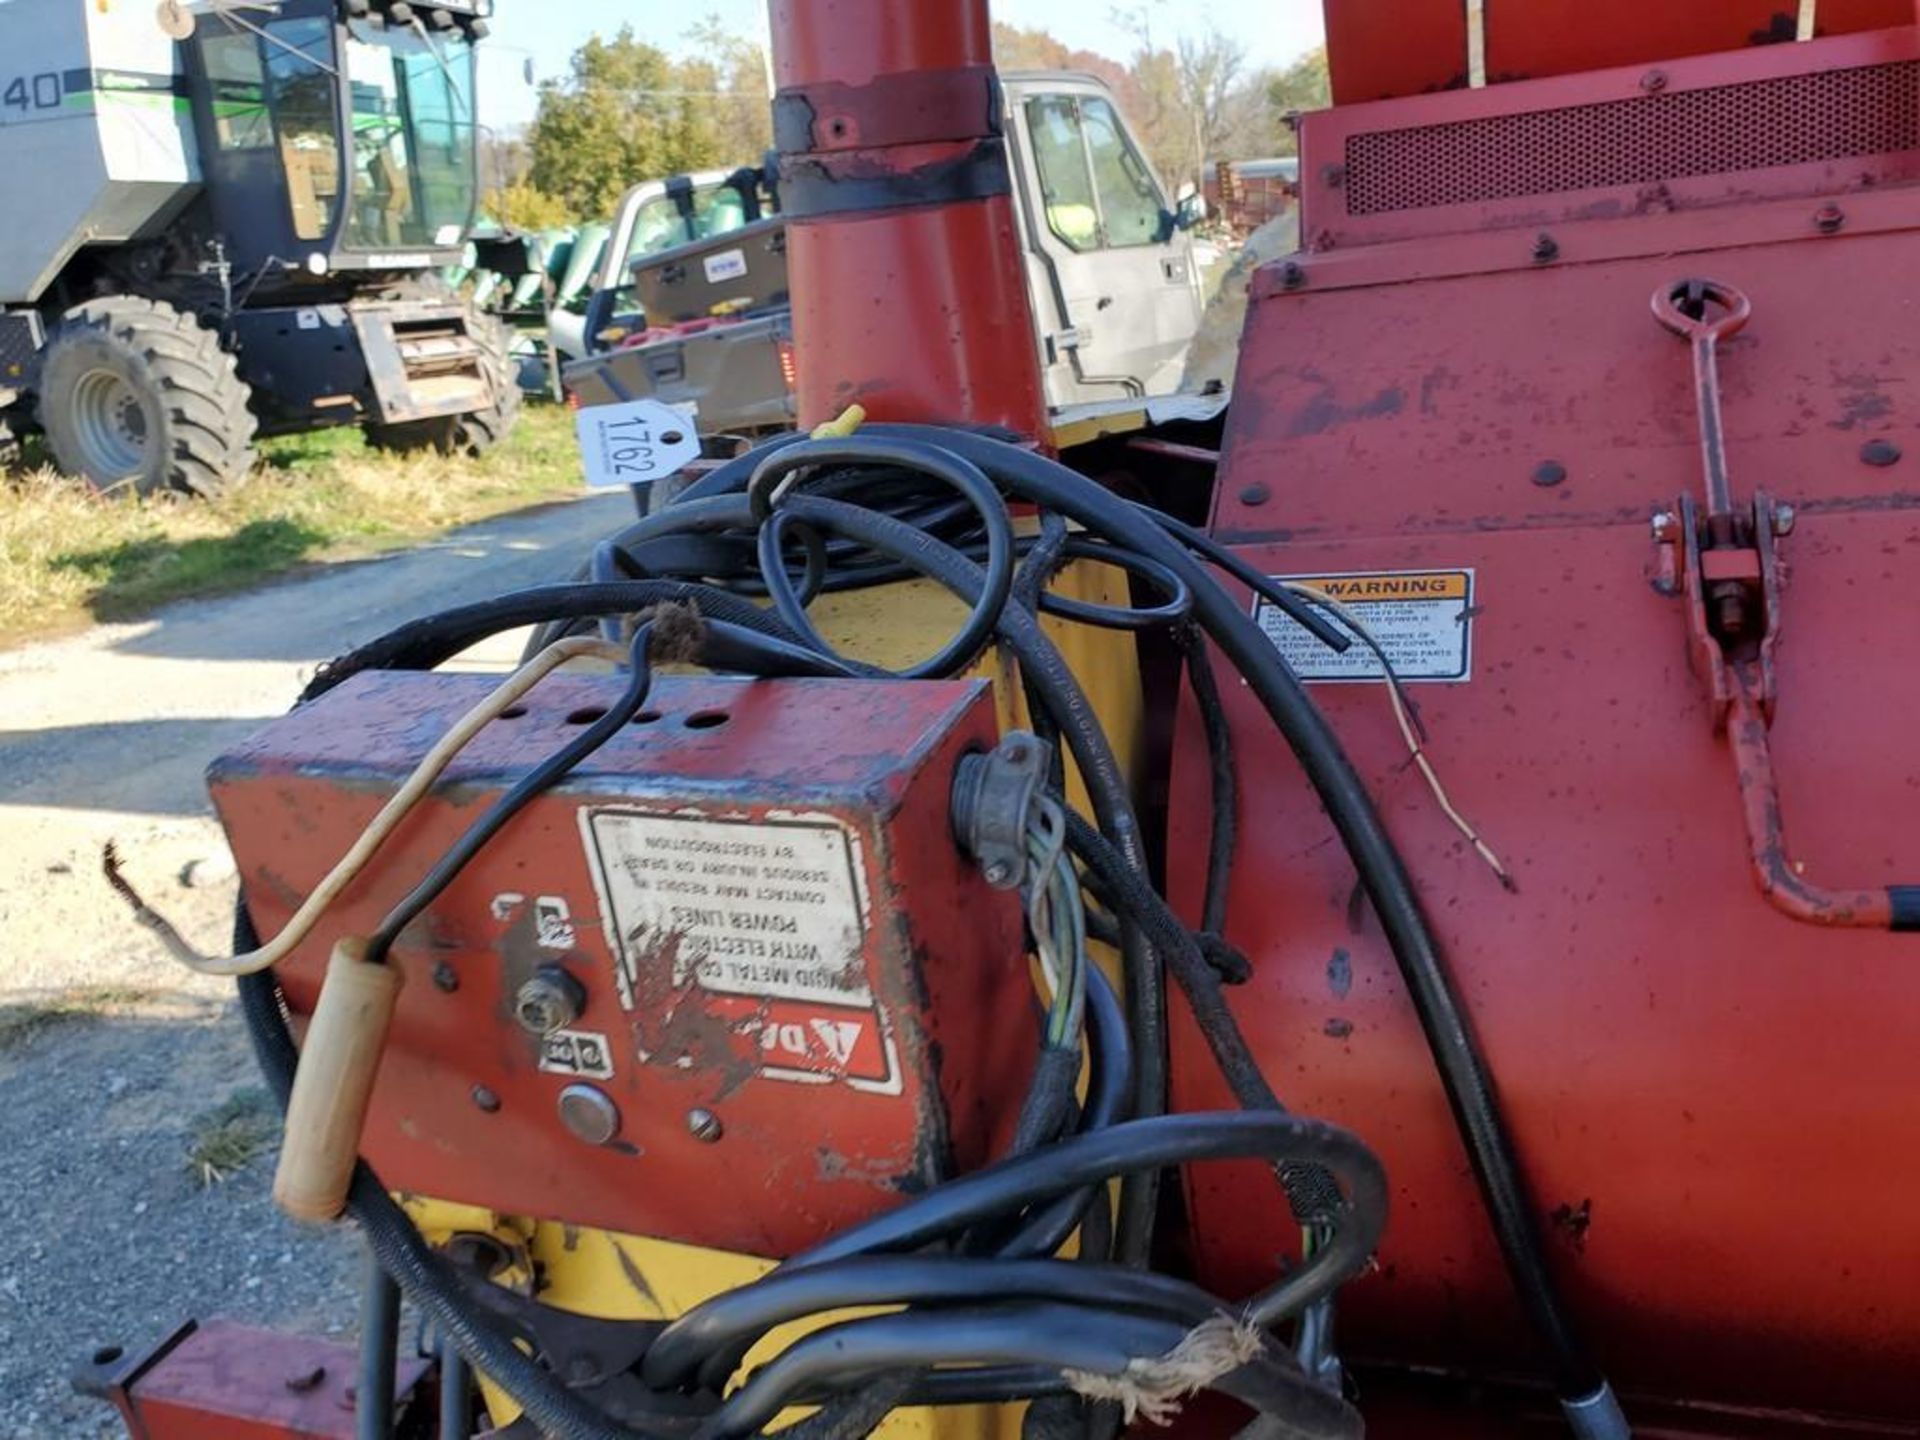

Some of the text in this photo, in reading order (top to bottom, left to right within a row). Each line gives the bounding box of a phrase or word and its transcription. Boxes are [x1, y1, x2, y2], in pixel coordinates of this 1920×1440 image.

[608, 416, 655, 475] 1762
[1324, 579, 1447, 596] WARNING
[645, 835, 795, 860] BY ELECTROCUTION
[702, 863, 758, 879] INJURY
[761, 867, 831, 883] SERIOUS
[656, 879, 709, 896] RESULT
[714, 882, 750, 899] MAY
[756, 884, 826, 904] CONTACT
[671, 906, 799, 933] POWER LINES
[770, 940, 821, 961] WITH
[725, 962, 788, 984] METAL
